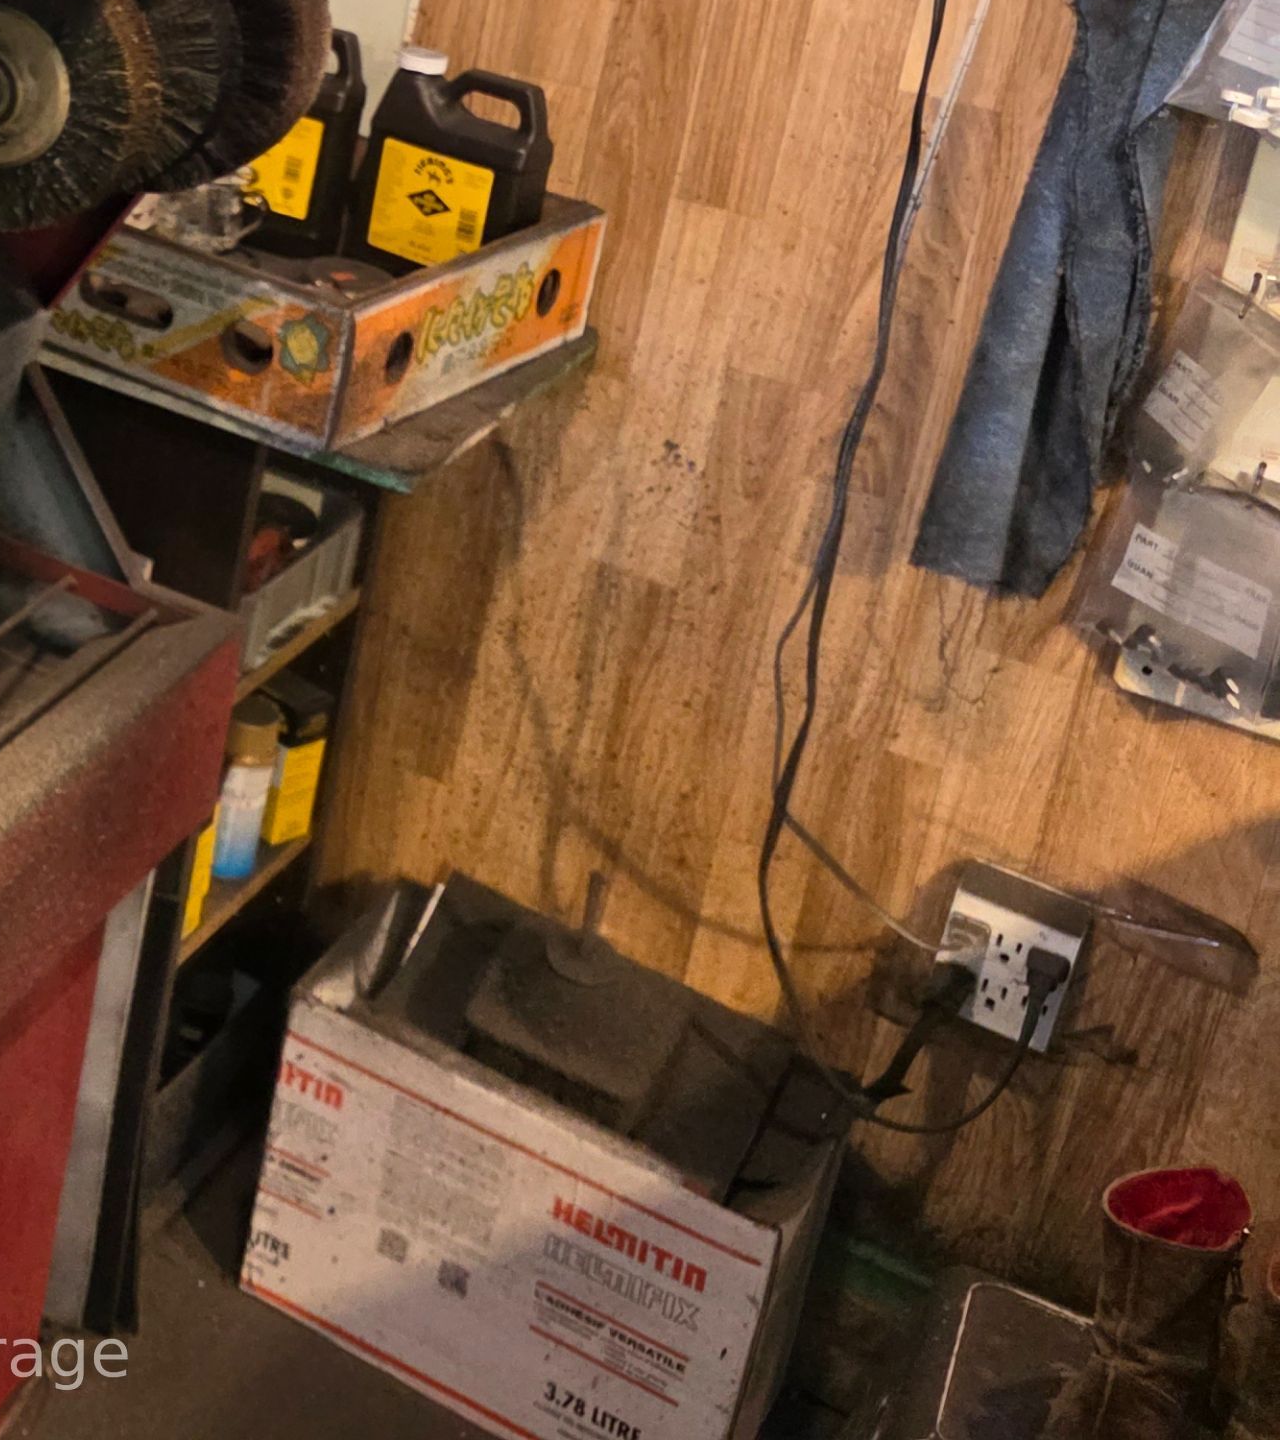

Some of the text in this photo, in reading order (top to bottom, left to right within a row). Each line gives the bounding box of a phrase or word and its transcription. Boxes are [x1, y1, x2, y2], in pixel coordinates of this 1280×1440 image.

[552, 1194, 708, 1294] HELMITIN
[608, 1327, 687, 1375] VERSATILE
[543, 1380, 587, 1418] 3.78
